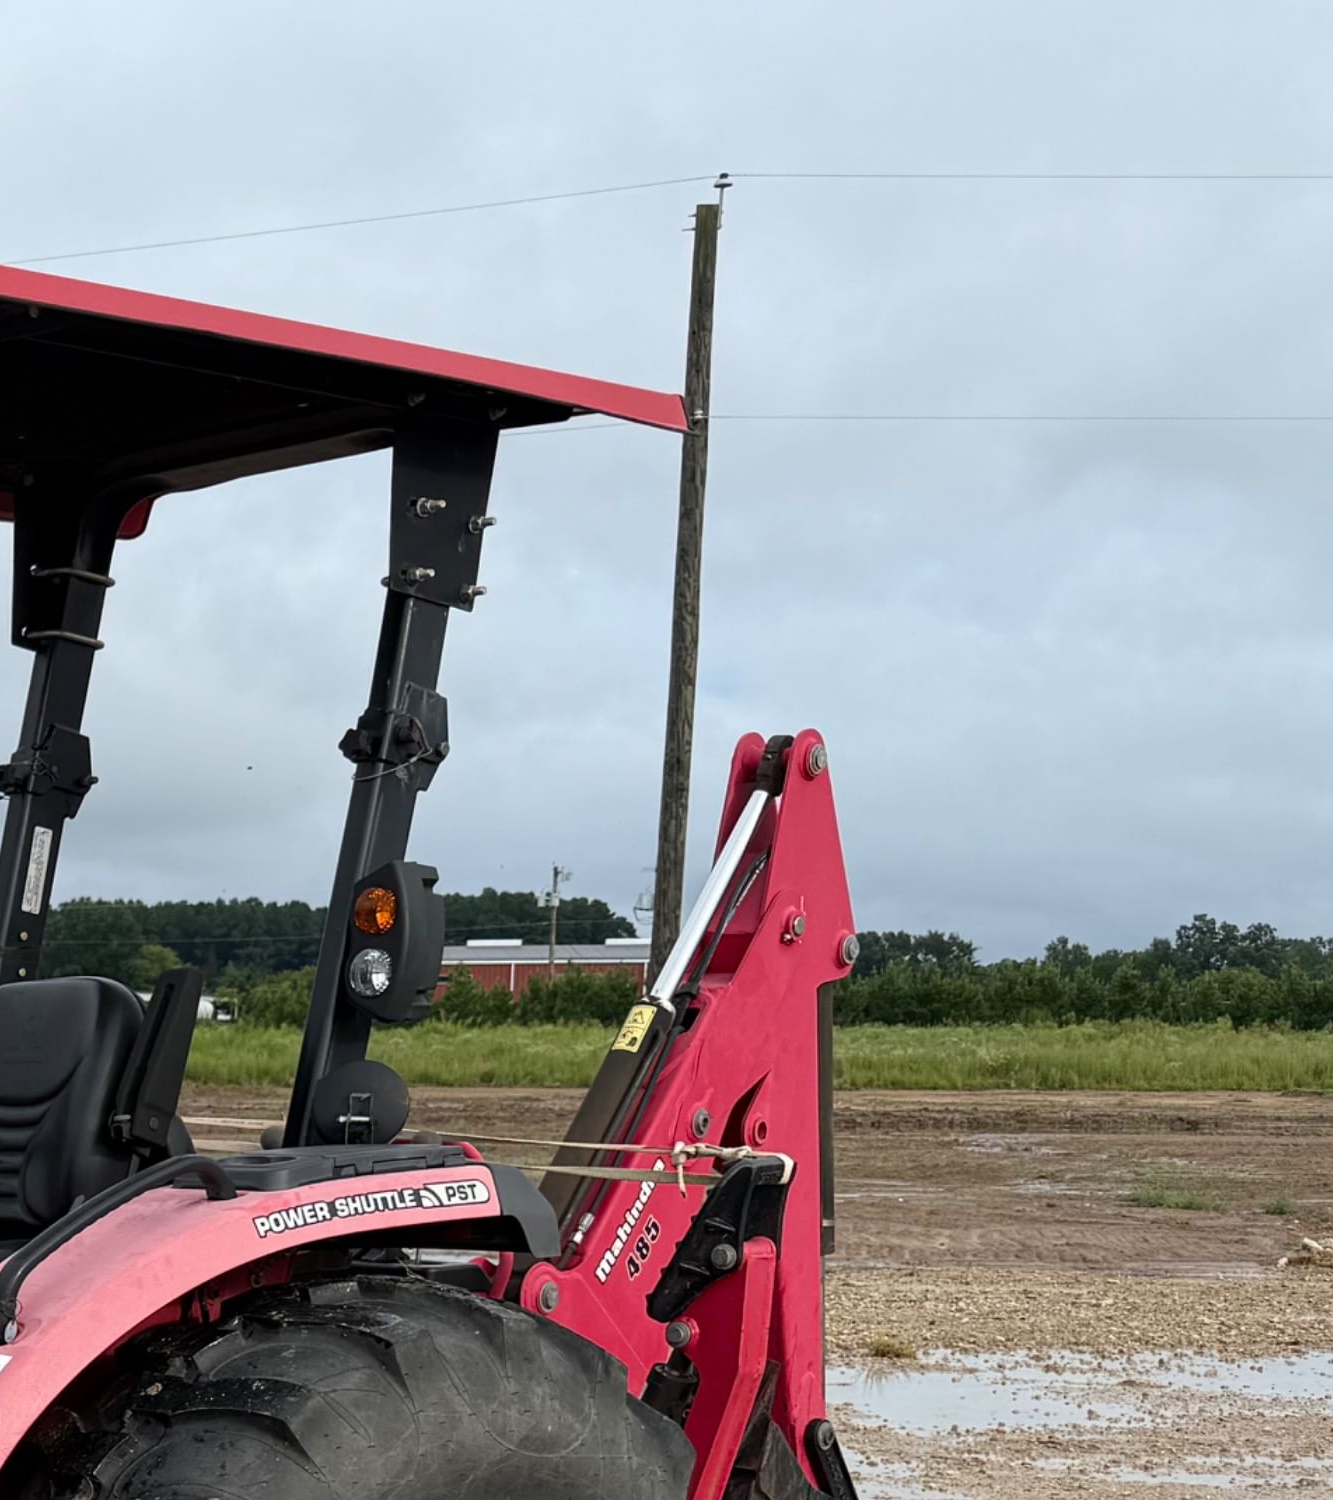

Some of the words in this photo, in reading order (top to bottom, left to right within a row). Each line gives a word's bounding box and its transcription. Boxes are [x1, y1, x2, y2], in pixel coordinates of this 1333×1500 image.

[253, 1202, 331, 1237] POWER
[334, 1189, 417, 1217] SHUTTLE
[446, 1184, 478, 1202] PST
[625, 1213, 661, 1281] 485
